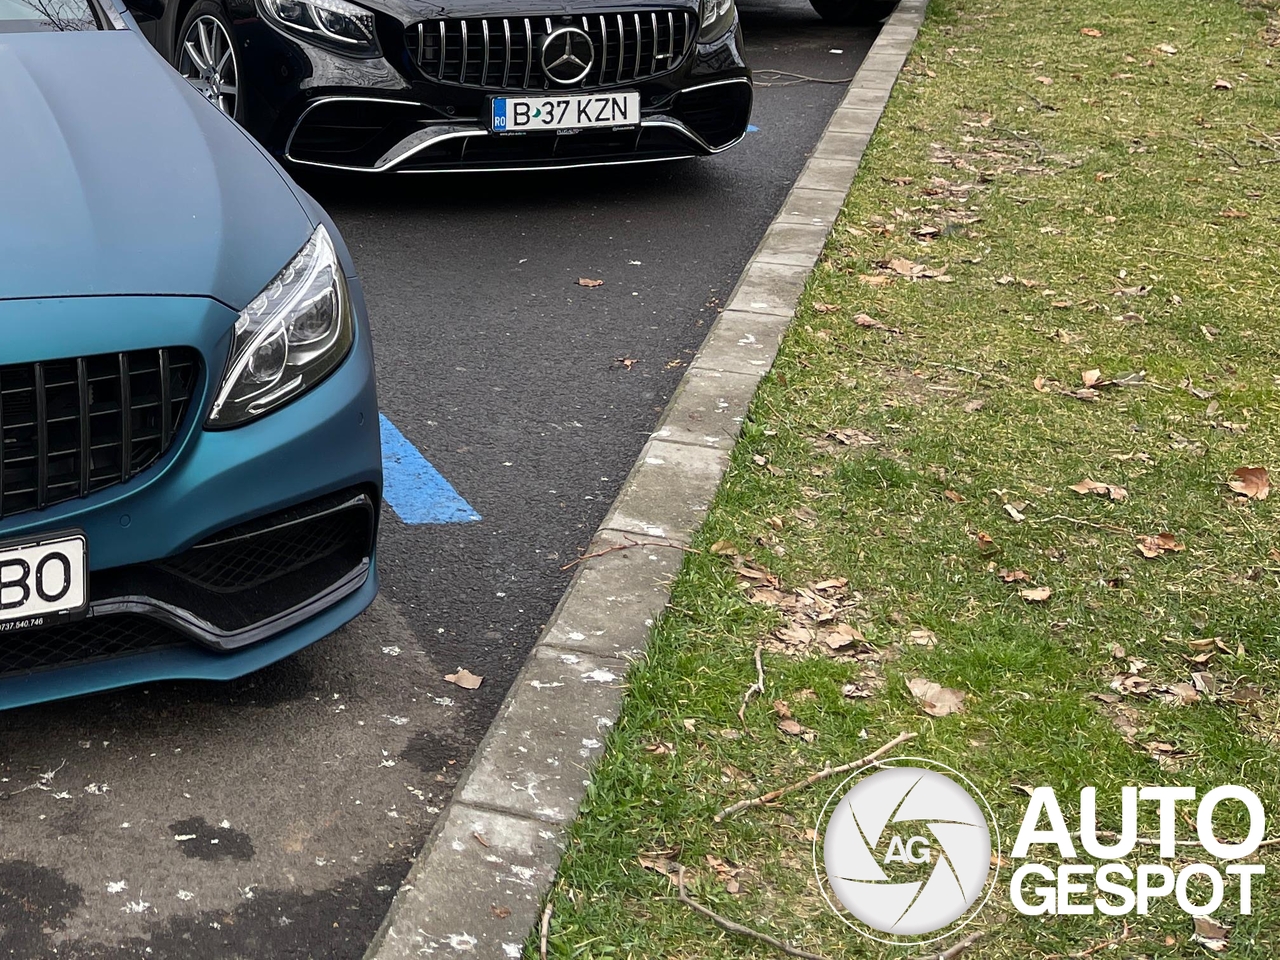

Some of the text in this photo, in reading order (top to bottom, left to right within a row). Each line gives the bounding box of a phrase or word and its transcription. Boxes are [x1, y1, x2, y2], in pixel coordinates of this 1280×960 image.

[494, 116, 506, 127] RO
[513, 96, 628, 127] B 37 KZN
